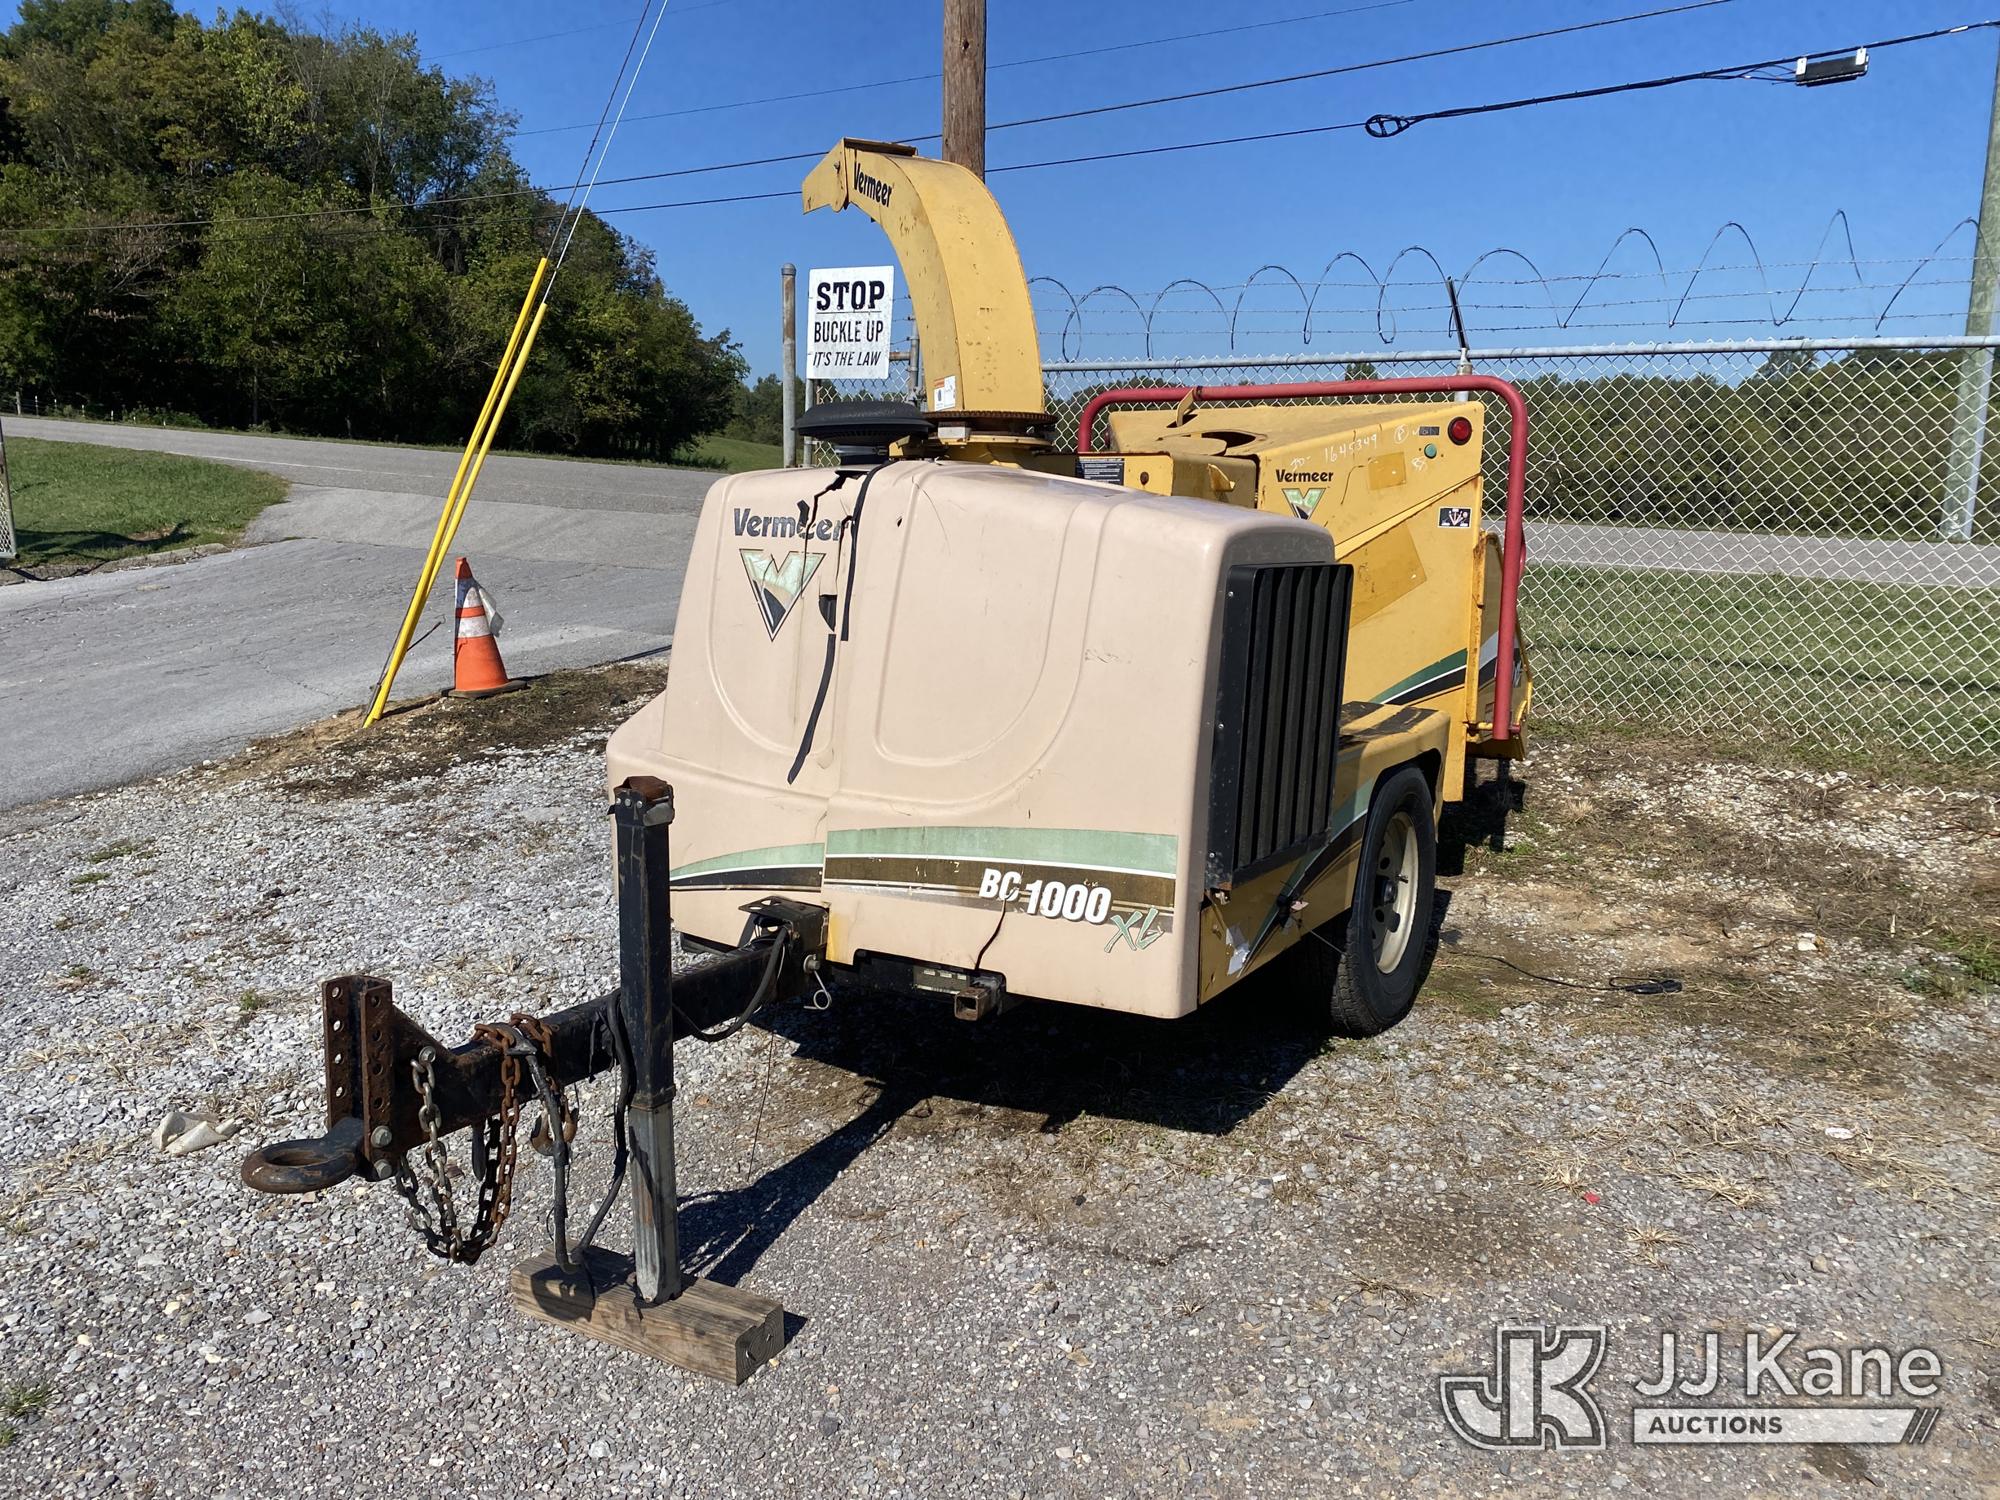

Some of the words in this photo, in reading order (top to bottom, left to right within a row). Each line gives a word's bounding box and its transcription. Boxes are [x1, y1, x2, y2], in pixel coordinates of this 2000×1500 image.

[853, 162, 894, 207] Vermeer
[816, 280, 885, 311] STOP
[814, 320, 862, 343] BUCKLE
[866, 320, 884, 343] UP
[812, 351, 832, 368] IT'S
[834, 351, 855, 367] THE
[856, 351, 882, 367] LAW
[1276, 469, 1334, 483] Vermeer
[1025, 879, 1112, 925] 1000
[1103, 907, 1165, 953] XL
